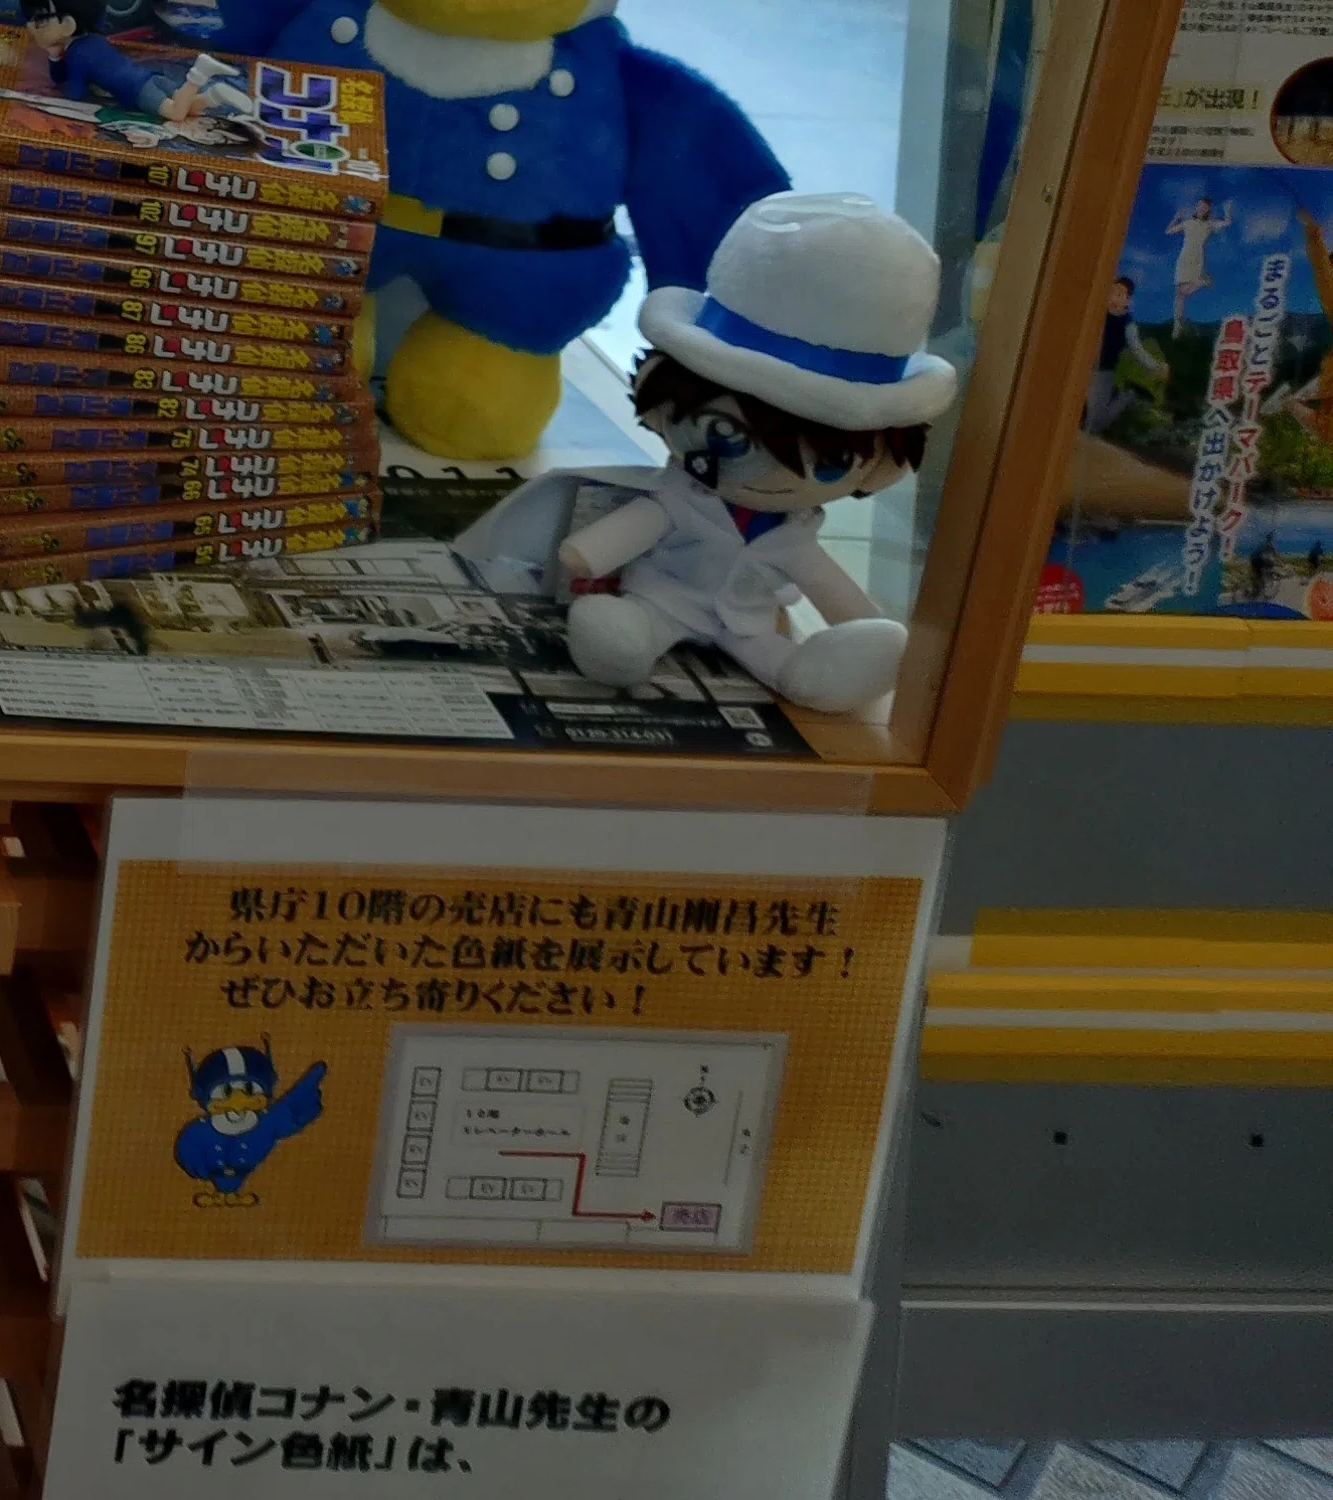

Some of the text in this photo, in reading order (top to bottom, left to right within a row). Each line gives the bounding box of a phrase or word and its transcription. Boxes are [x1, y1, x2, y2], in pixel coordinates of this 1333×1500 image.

[148, 163, 170, 188] 107
[140, 199, 162, 224] 102
[135, 233, 158, 256] 97
[129, 266, 153, 289] 96
[121, 299, 144, 323] 87
[133, 368, 156, 390] 83
[157, 396, 180, 419] 82
[171, 427, 193, 449] 75
[184, 930, 857, 980] からいただいた色紙を展示しています!
[219, 976, 648, 1017] ぜひお立ち寄りください!
[114, 1380, 670, 1433] 名探偵コナン・青山先生の
[114, 1429, 472, 1474] 「サイン色紙」は、
